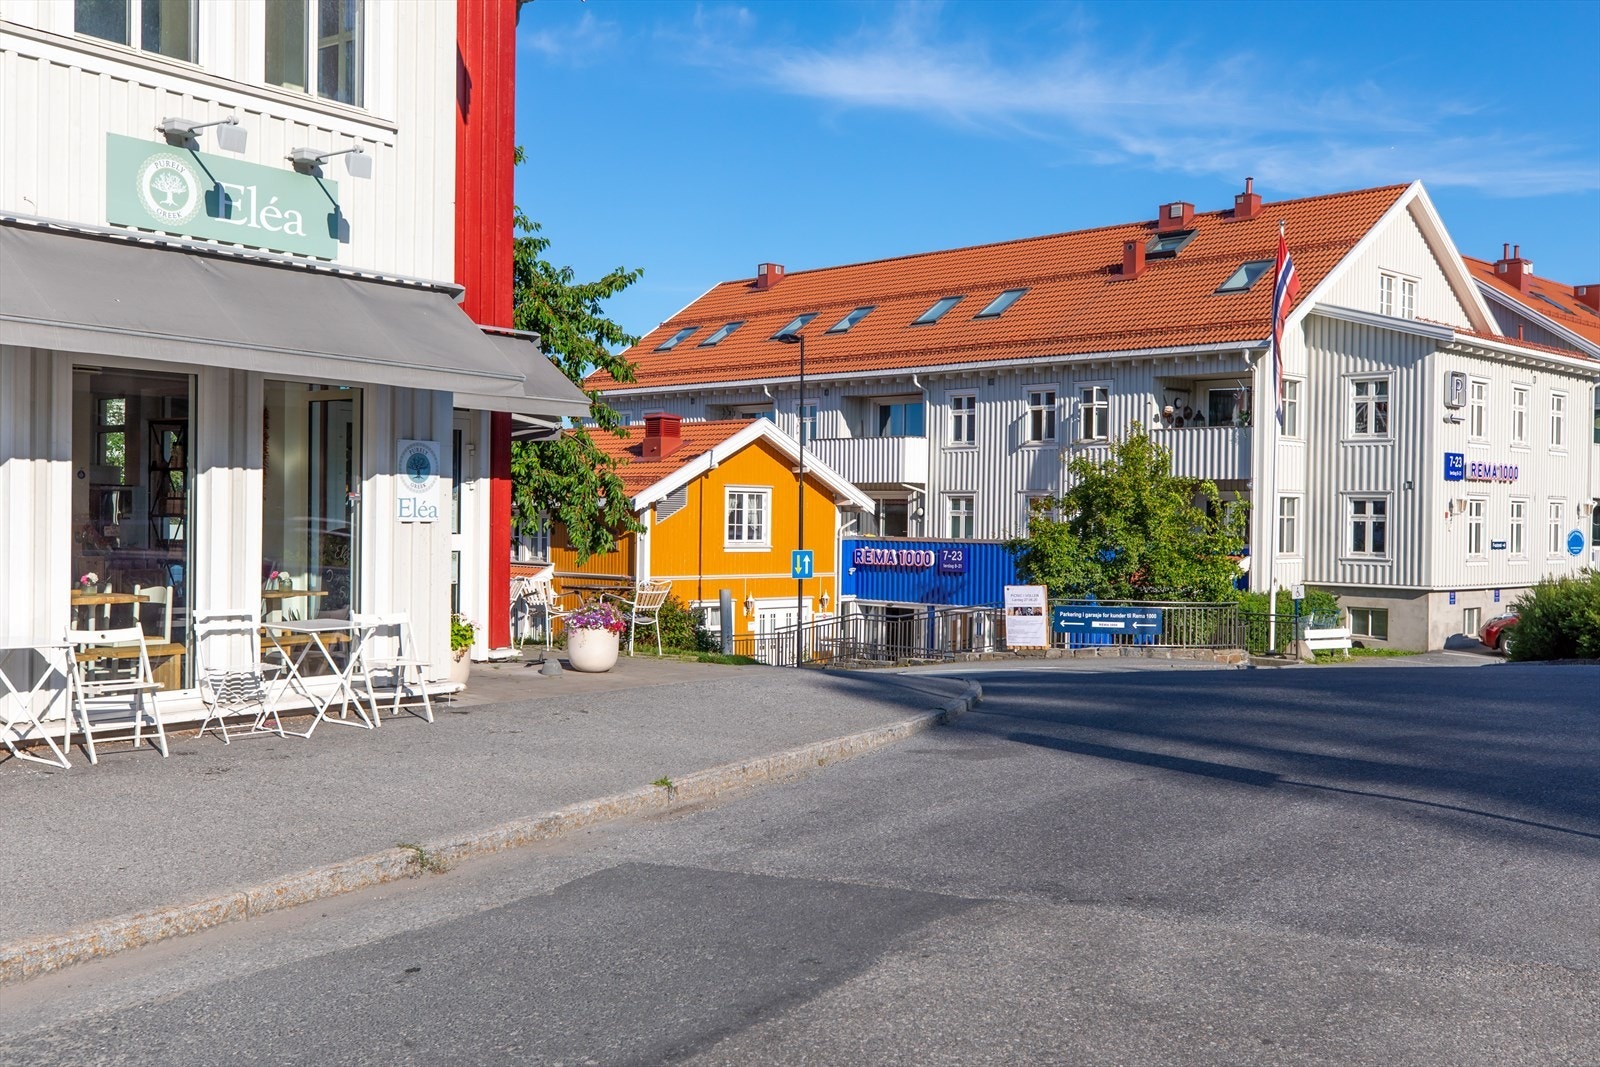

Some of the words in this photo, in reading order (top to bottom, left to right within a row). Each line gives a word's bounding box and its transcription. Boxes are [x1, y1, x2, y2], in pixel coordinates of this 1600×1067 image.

[154, 159, 186, 174] PURELY
[156, 207, 183, 219] GREEK
[214, 181, 306, 237] Eléa
[1449, 455, 1463, 468] 7-23
[1471, 462, 1497, 478] REMA
[1499, 464, 1519, 480] 1000
[398, 497, 438, 518] Eléa
[854, 548, 897, 566] REMA
[898, 549, 935, 567] 1000
[943, 550, 963, 561] 7-23
